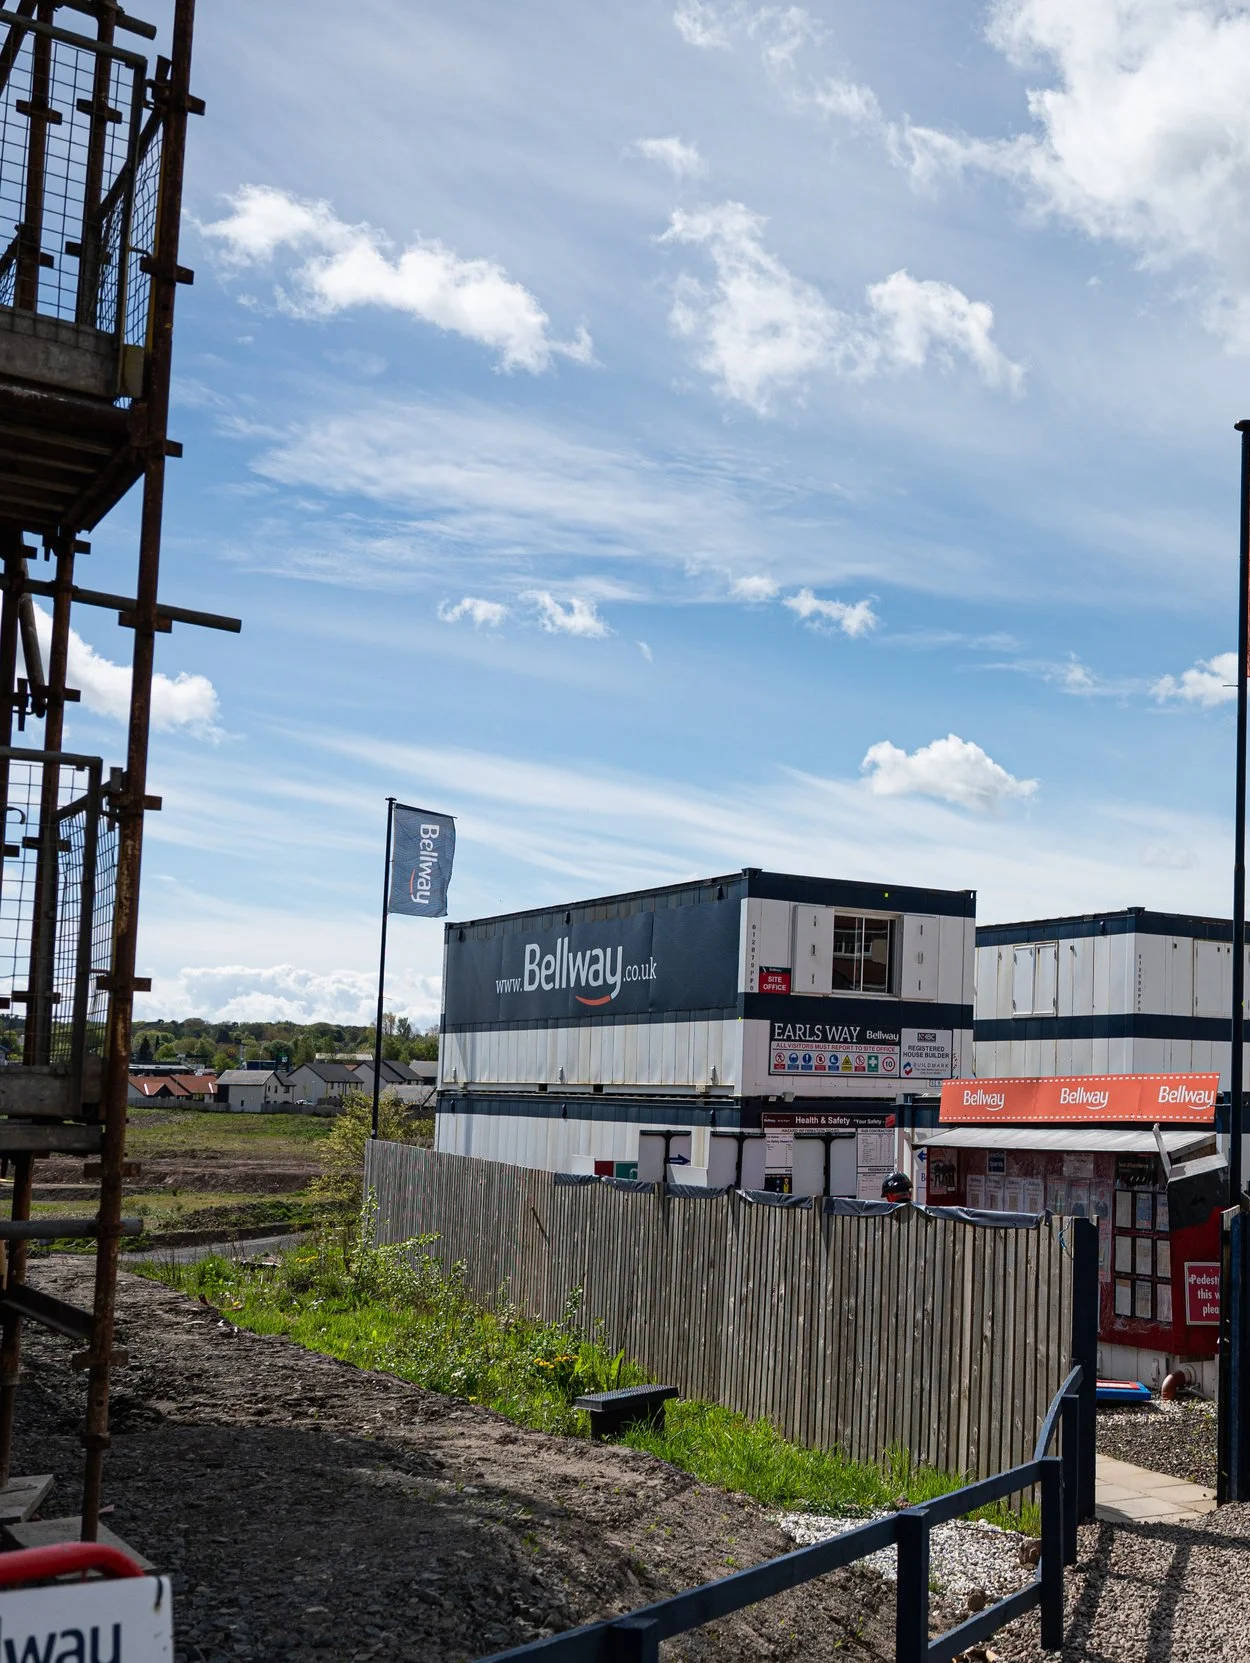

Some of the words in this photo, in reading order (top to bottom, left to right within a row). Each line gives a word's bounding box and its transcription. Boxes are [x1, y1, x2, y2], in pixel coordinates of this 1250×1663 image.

[410, 824, 440, 905] Bellway
[774, 1023, 822, 1040] EARLS
[825, 1025, 860, 1042] WAY
[866, 1030, 899, 1042] Bellway
[963, 1090, 1004, 1110] Bellway
[1060, 1088, 1109, 1110] Bellway
[1158, 1086, 1214, 1110] Bellway
[828, 1116, 850, 1125] Safety
[1198, 1288, 1212, 1299] this
[1203, 1303, 1220, 1317] plea
